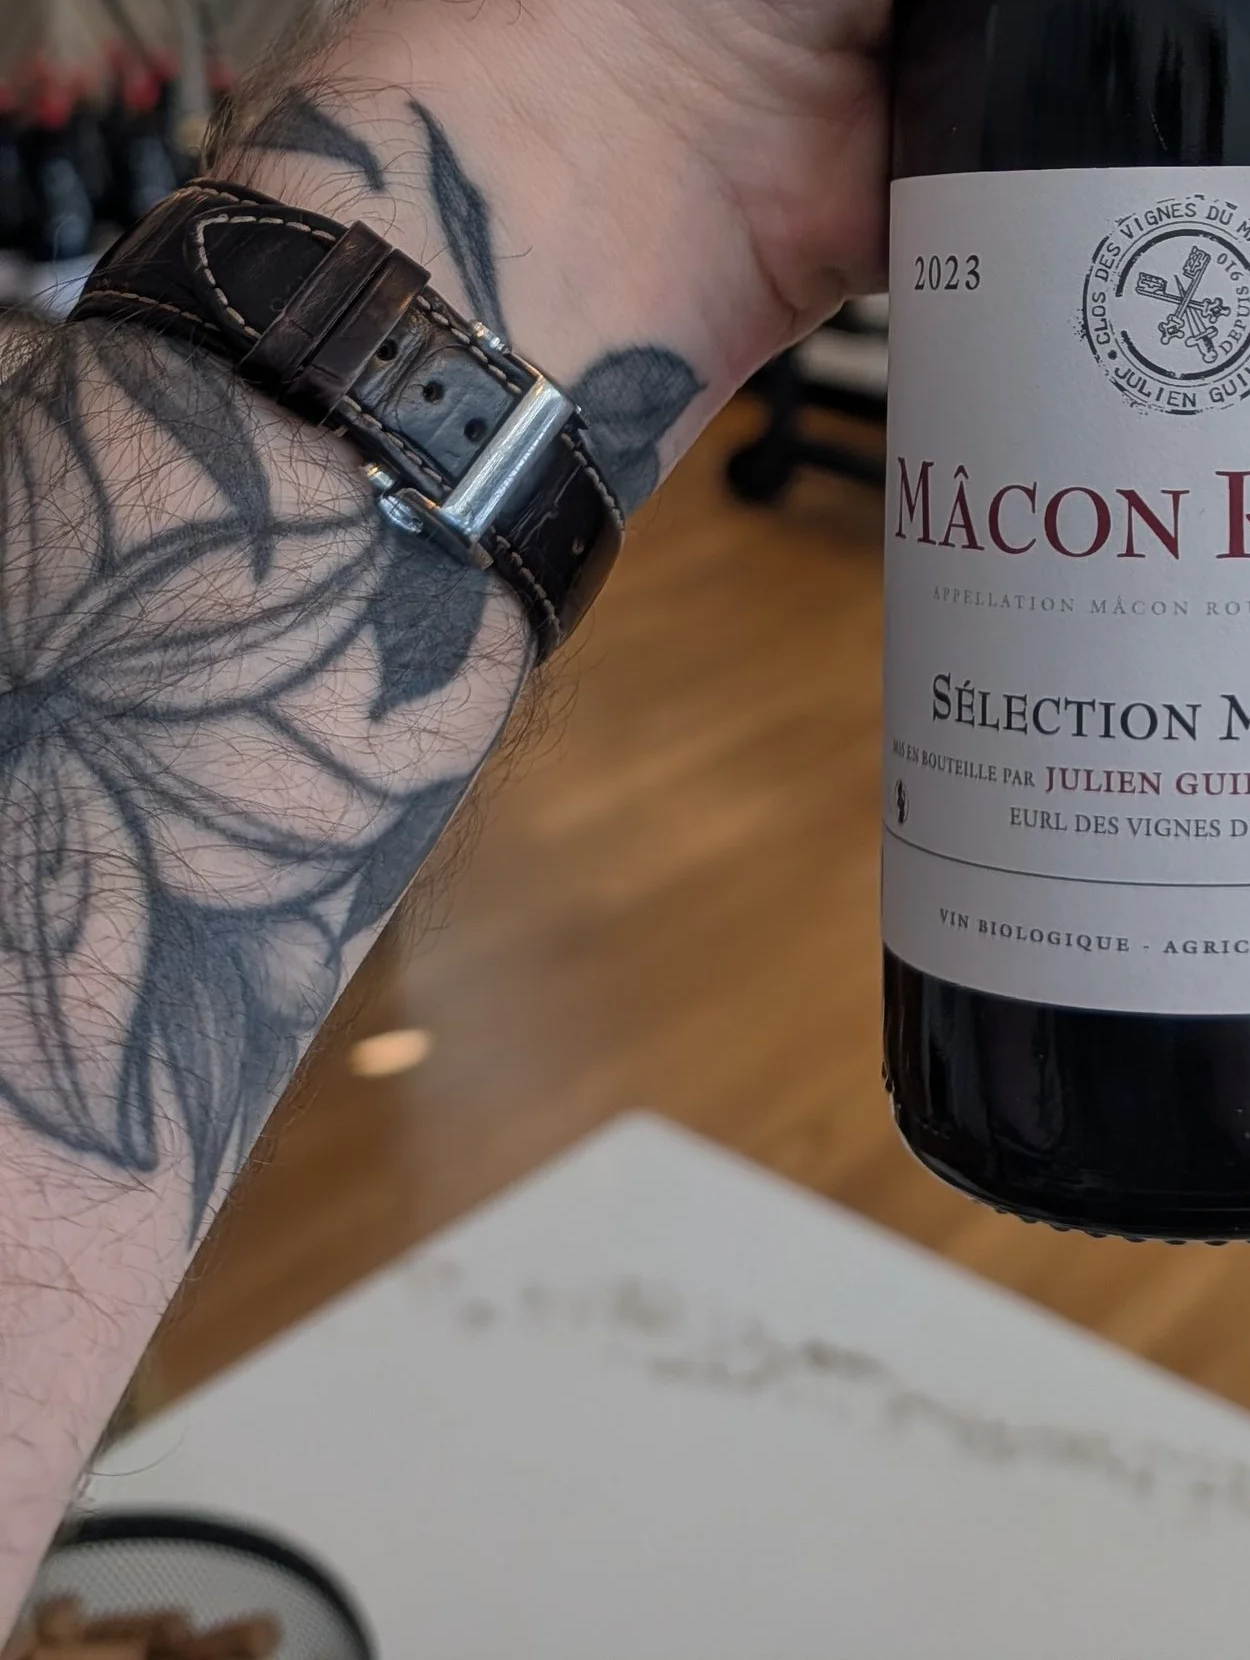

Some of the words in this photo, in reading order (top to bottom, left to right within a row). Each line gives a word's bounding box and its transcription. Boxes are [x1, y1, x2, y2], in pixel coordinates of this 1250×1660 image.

[1120, 202, 1197, 239] VIGNES
[1206, 205, 1235, 226] DU
[914, 254, 981, 291] 2023
[1095, 242, 1121, 282] DES
[1216, 252, 1244, 282] 910
[1091, 291, 1111, 345] CLOS
[1218, 285, 1250, 356] DEPUIS
[1114, 367, 1197, 408] JULIEN
[895, 456, 1191, 561] MÂCON
[932, 585, 1075, 613] APPELLATION
[1090, 596, 1189, 617] MÂCON
[932, 672, 1202, 741] SÉLECTION
[906, 743, 919, 764] EN
[922, 750, 998, 782] BOUTEILLE
[1003, 767, 1036, 788] PAR
[1045, 765, 1162, 796] JULIEN
[1010, 807, 1067, 832] EURL
[1075, 814, 1119, 836] DES
[1126, 817, 1221, 838] VIGNES
[939, 907, 969, 930] VIN
[978, 918, 1131, 953] BIOLOGIQUE
